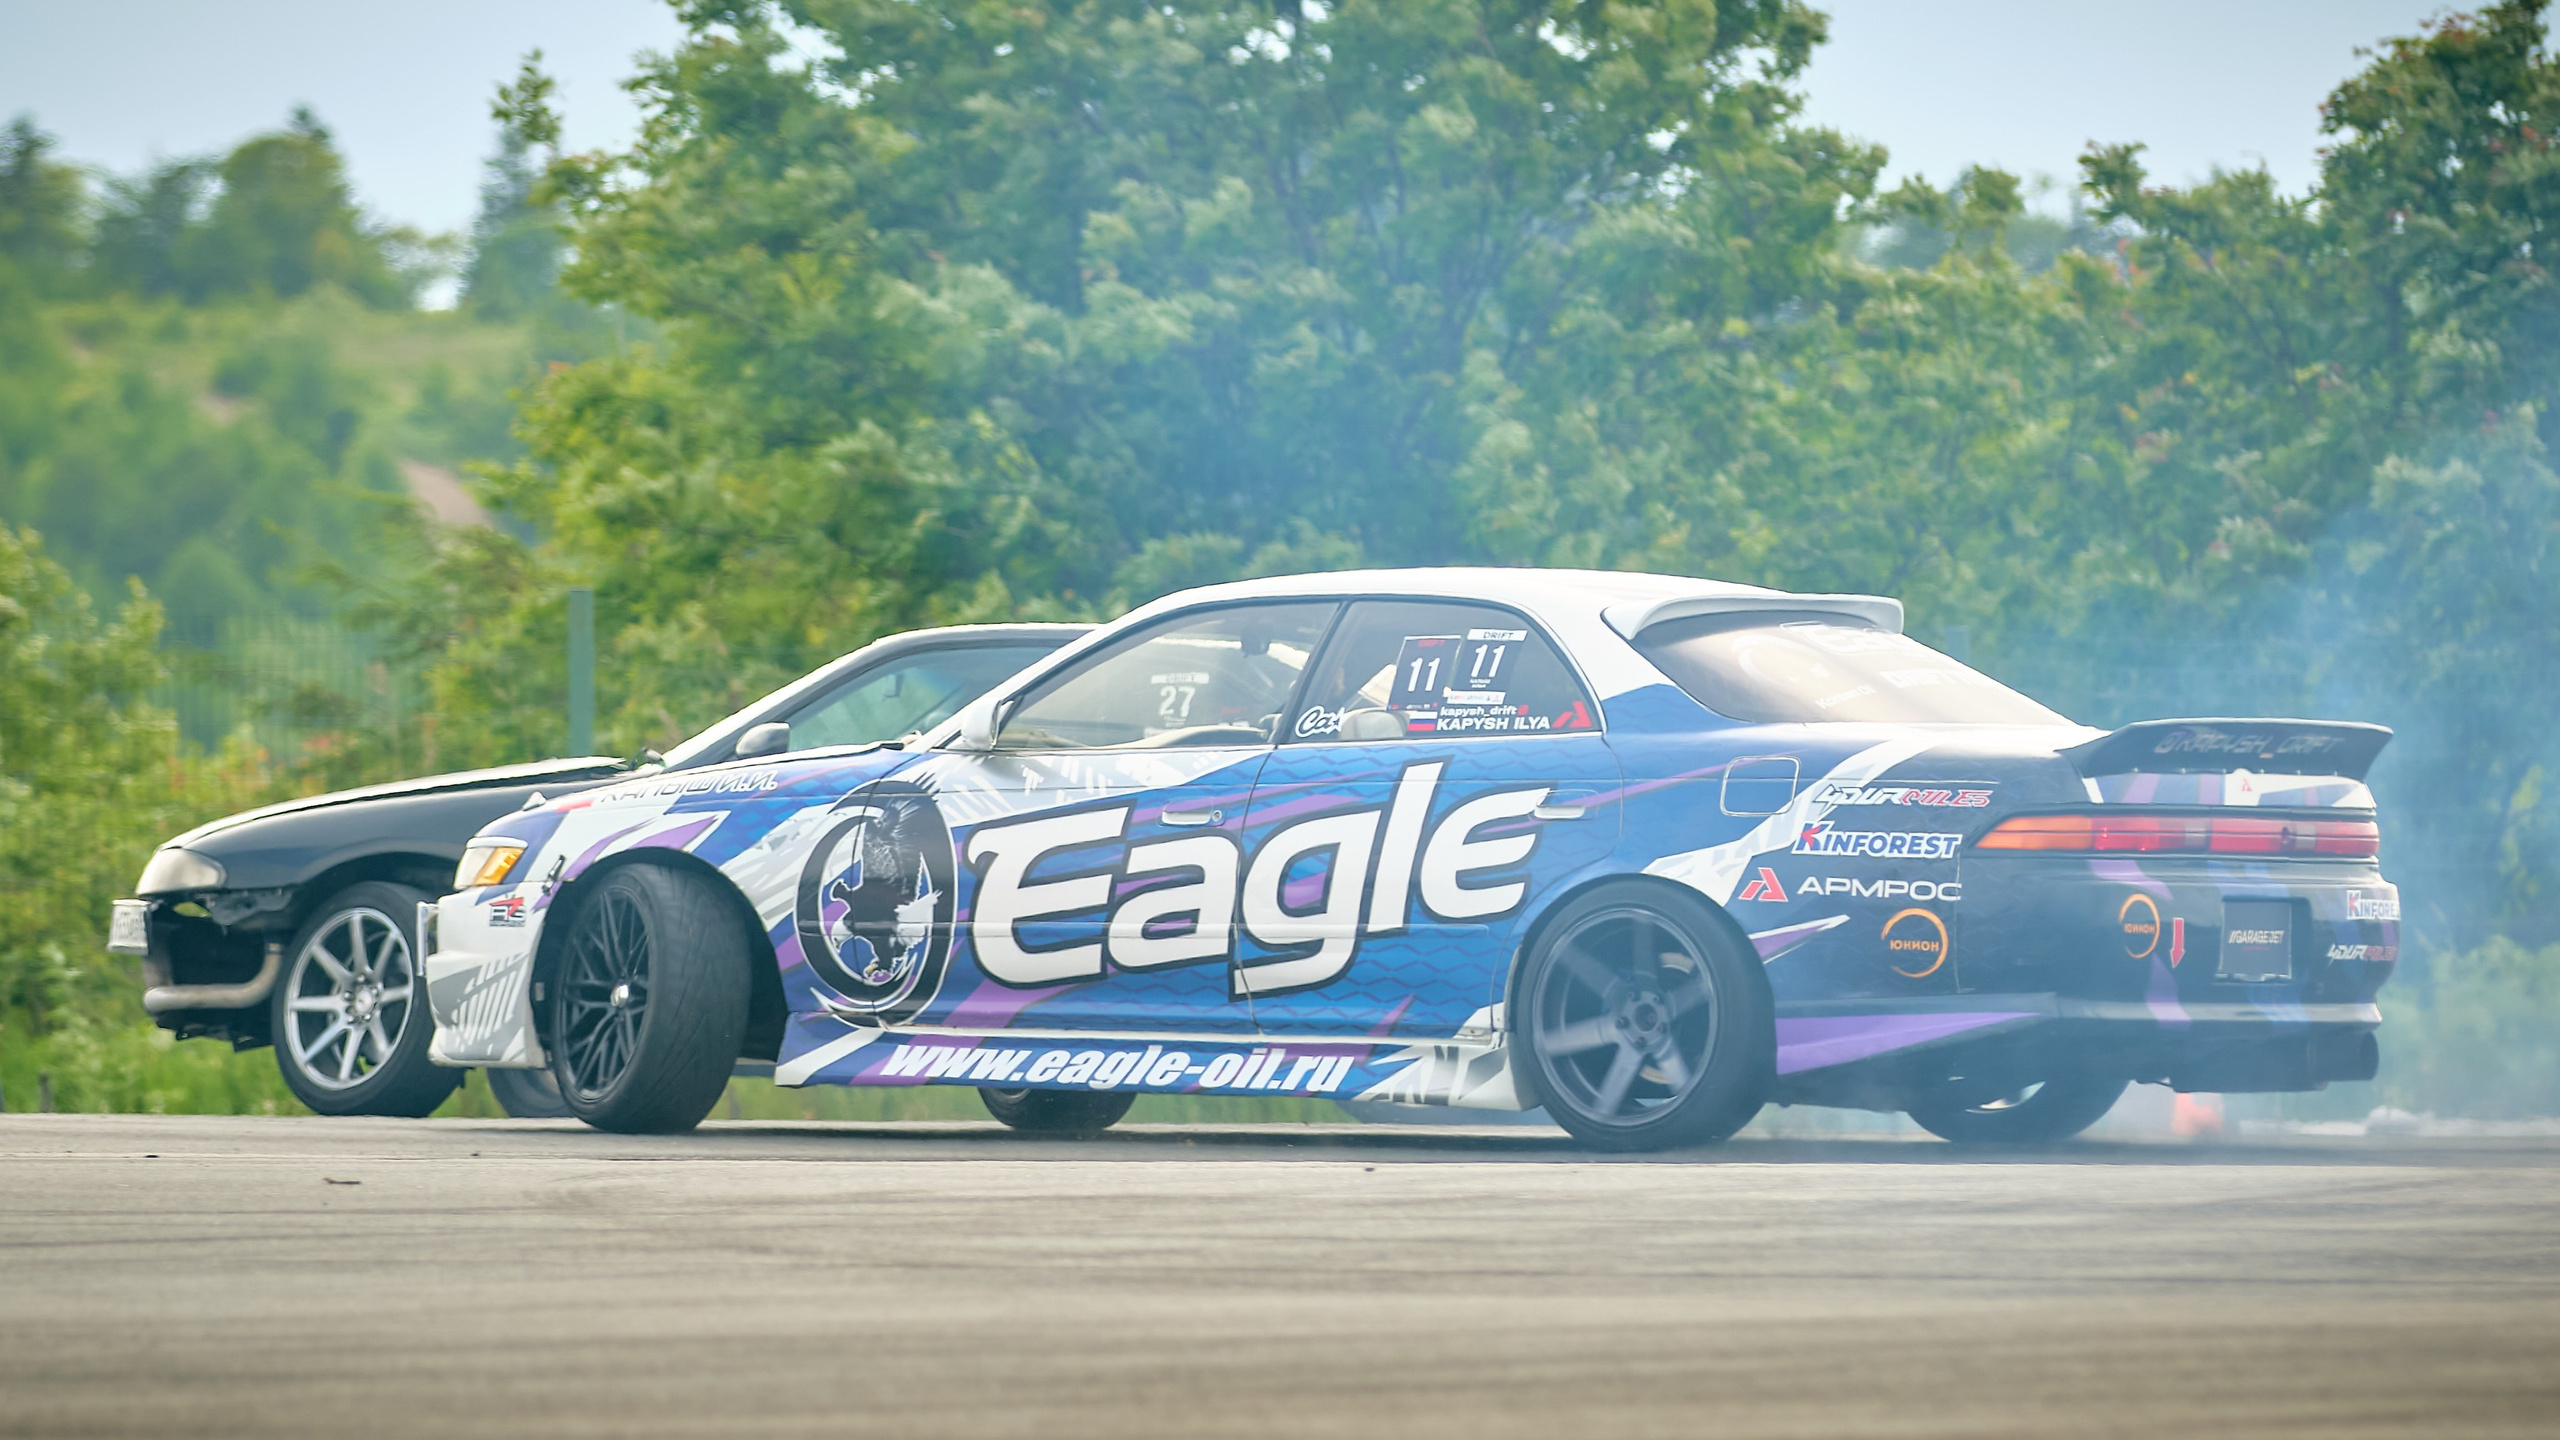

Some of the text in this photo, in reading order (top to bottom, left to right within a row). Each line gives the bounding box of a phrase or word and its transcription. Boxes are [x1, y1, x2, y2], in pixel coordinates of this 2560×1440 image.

[1483, 631, 1514, 639] DRIFT
[1407, 657, 1441, 692] 11
[1470, 644, 1506, 678] 11
[1159, 685, 1195, 717] 27
[1440, 705, 1518, 717] kapysh_drift
[1437, 716, 1550, 731] KAPYSH ILYA
[1795, 822, 1960, 857] KINFOREST
[966, 758, 1551, 996] Eagle
[1797, 876, 1962, 901] АРМРОС
[1889, 938, 1940, 952] ЮНИОН
[880, 1043, 1355, 1092] www.eagle-oil.ru
